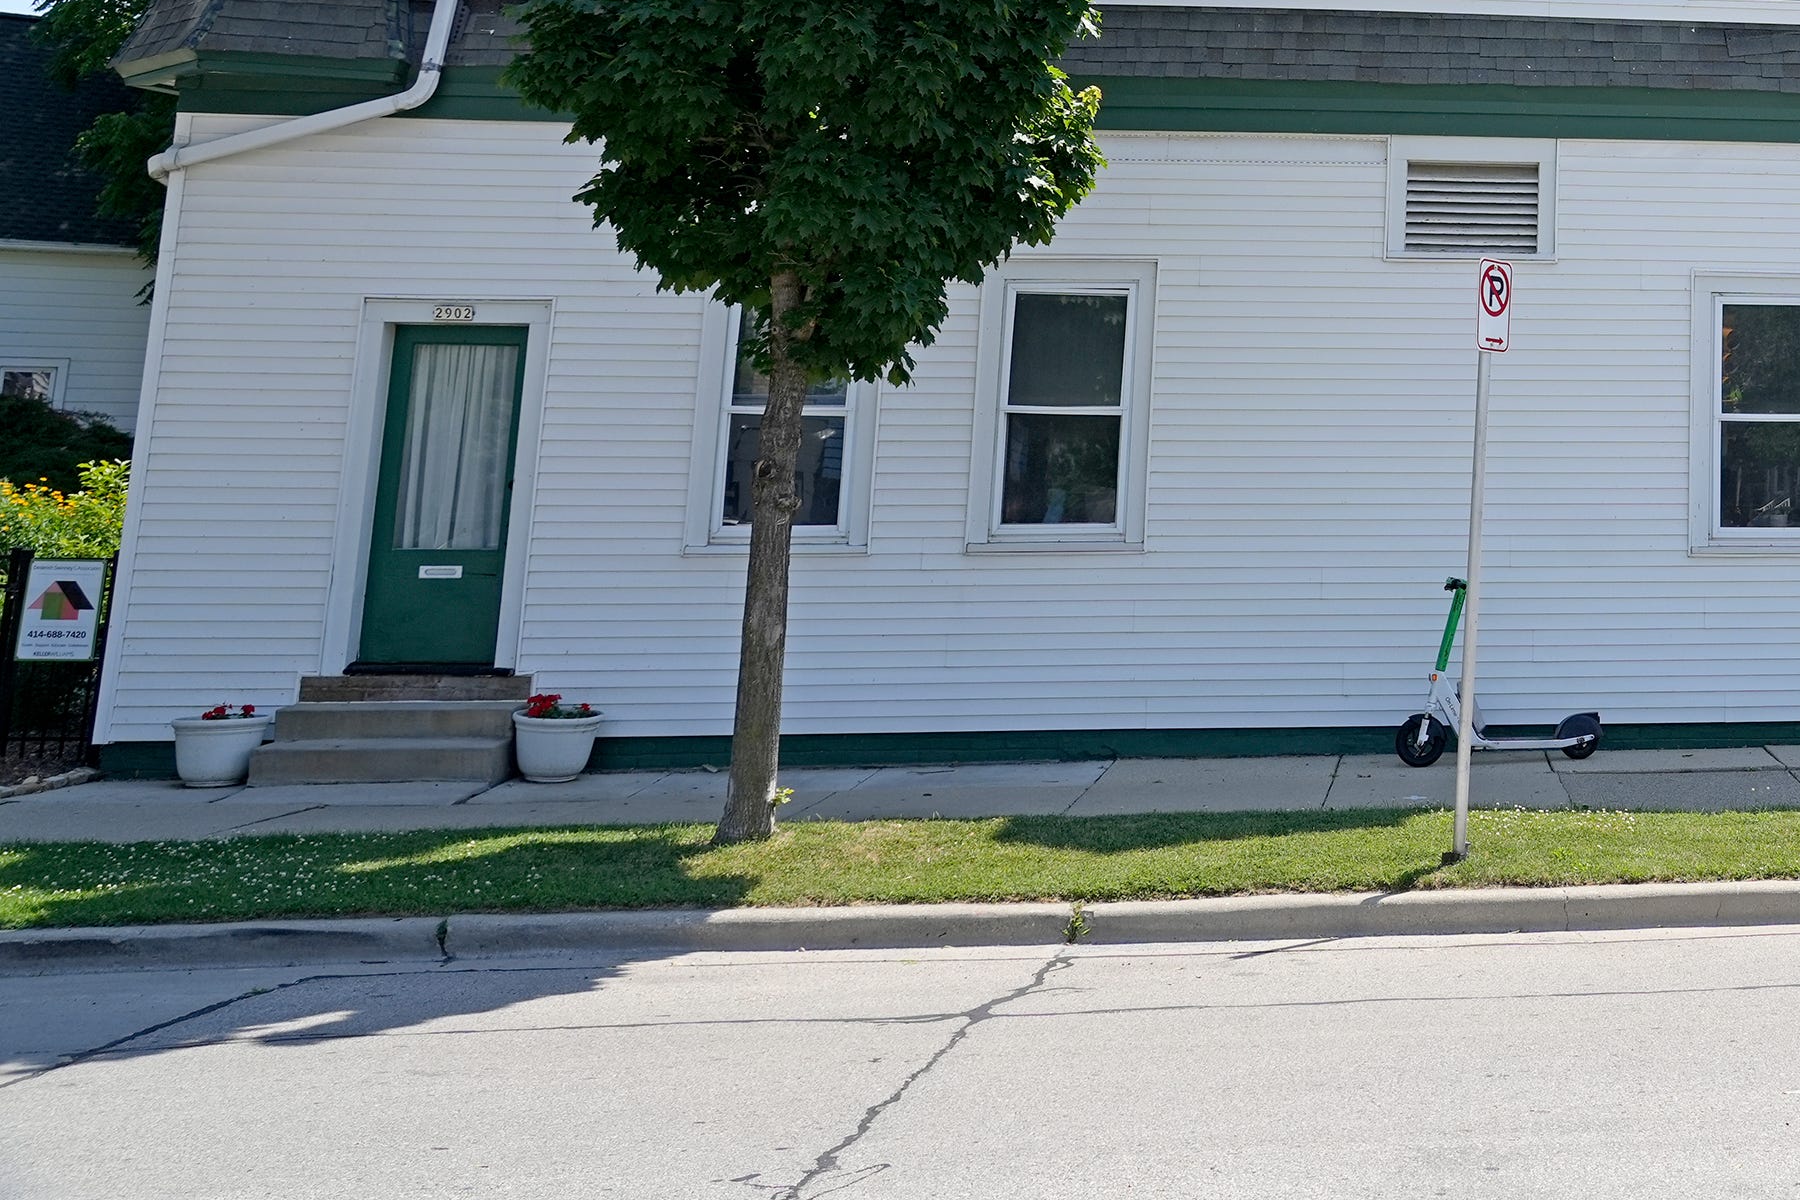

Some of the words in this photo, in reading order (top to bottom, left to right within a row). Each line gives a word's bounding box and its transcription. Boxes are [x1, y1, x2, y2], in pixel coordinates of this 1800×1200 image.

[1488, 275, 1505, 307] P
[435, 307, 471, 319] 2902
[27, 630, 87, 639] 414-688-7420
